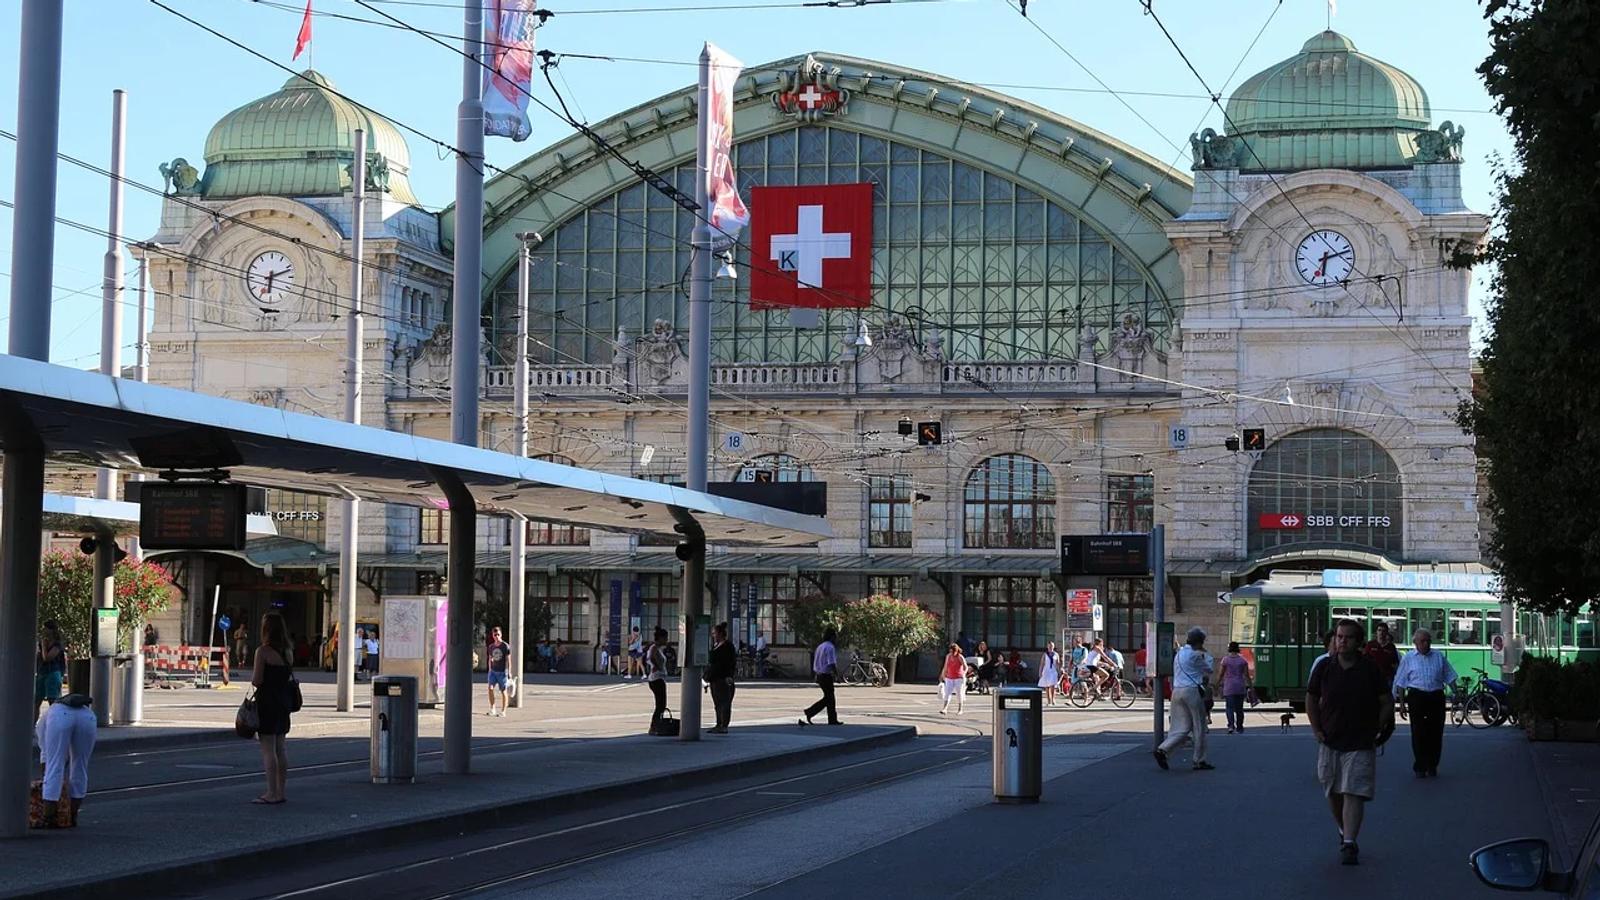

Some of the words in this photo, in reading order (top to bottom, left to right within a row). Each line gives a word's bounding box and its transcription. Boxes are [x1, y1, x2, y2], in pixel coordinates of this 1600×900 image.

[781, 251, 796, 268] K
[729, 435, 740, 448] 18
[1173, 429, 1185, 442] 18
[744, 470, 754, 481] 15
[277, 511, 298, 521] CFF
[300, 511, 319, 521] FFS
[1307, 515, 1334, 527] SBB
[1339, 515, 1364, 527] CFF
[1367, 515, 1391, 527] FFS
